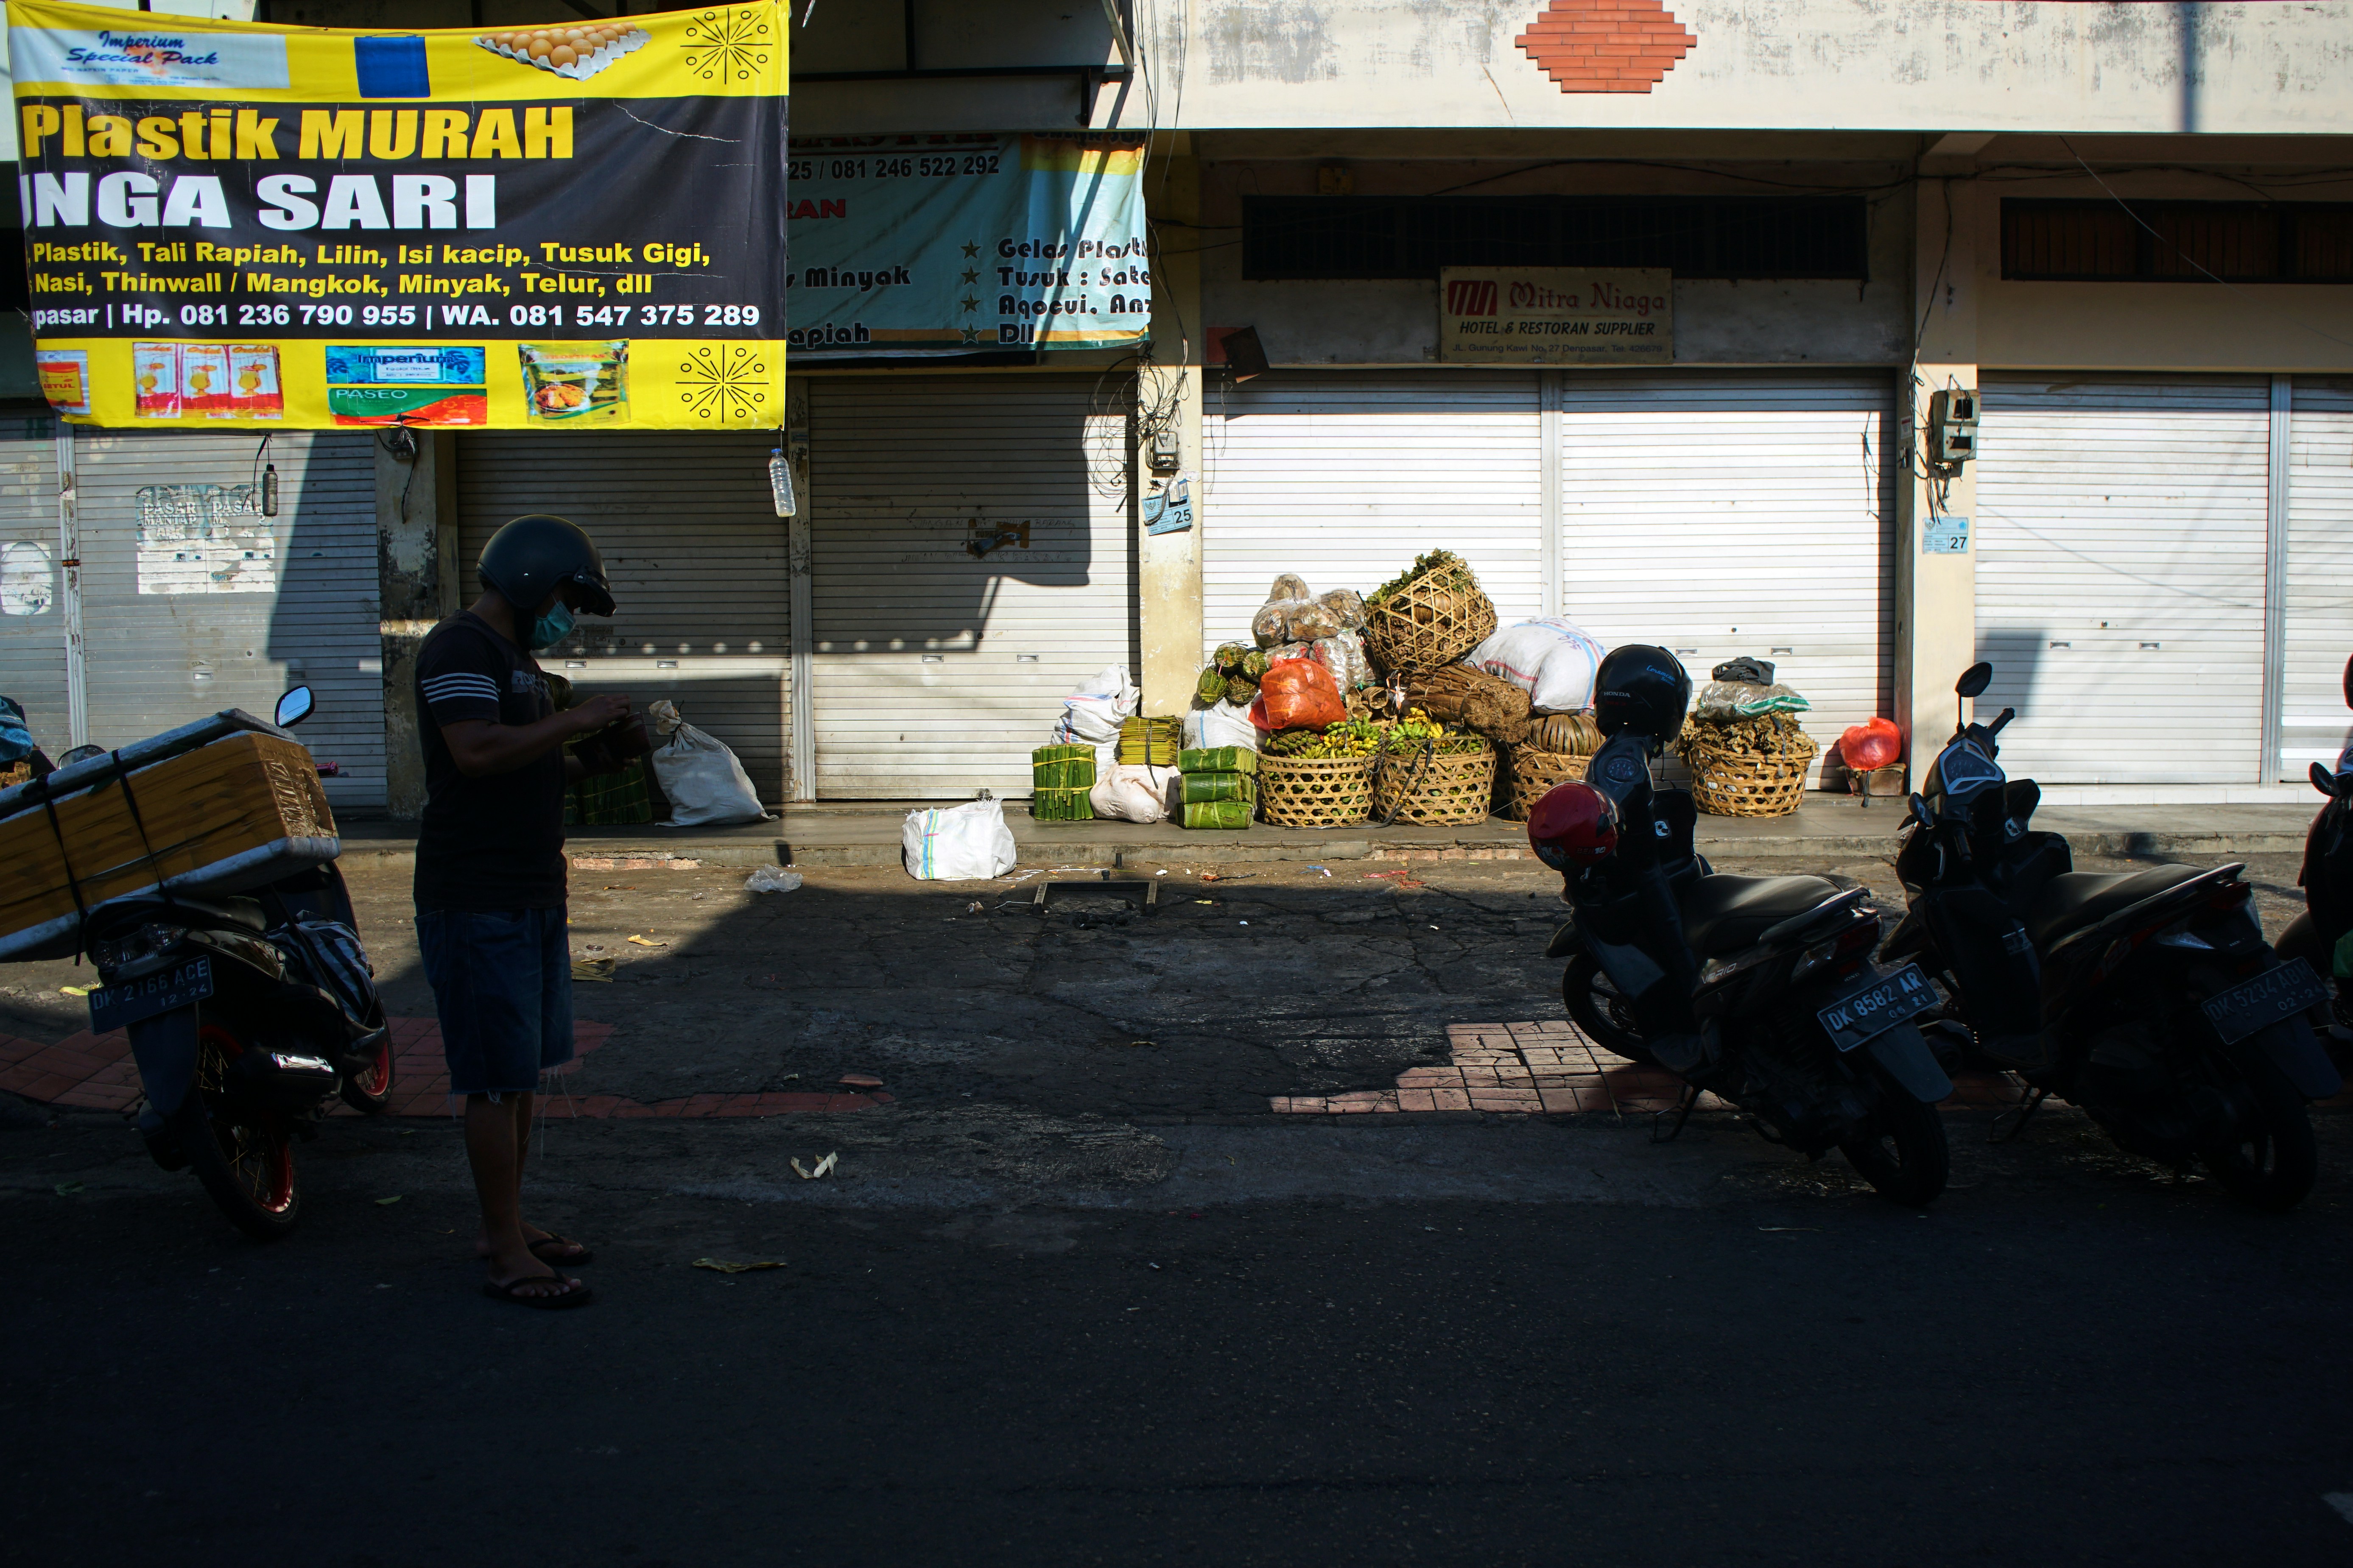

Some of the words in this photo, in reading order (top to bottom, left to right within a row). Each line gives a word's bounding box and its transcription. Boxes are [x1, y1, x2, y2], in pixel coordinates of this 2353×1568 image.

[99, 31, 184, 50] Imperium
[67, 48, 152, 64] Special
[162, 50, 219, 64] Pack
[22, 105, 279, 160] Plastik
[299, 106, 573, 160] MURAH
[832, 159, 866, 179] 081
[875, 158, 910, 178] 246
[919, 156, 956, 177] 522
[962, 155, 1000, 175] 292
[257, 175, 495, 230] SARI
[34, 242, 127, 266] Plastik,
[137, 242, 186, 262] Tali
[196, 243, 306, 268] Rapiah,
[317, 245, 388, 268] Lilin,
[399, 245, 433, 264] Isi
[443, 244, 530, 267] kacip,
[540, 242, 633, 262] Tusuk
[643, 242, 710, 268] Gigi,
[998, 238, 1068, 259] Gelas
[36, 272, 92, 296] Nasi,
[101, 272, 221, 292] Thinwall
[247, 273, 388, 298] Mangkok,
[399, 273, 510, 298] Minyak,
[520, 273, 605, 297] Telur,
[616, 273, 651, 295] dll
[805, 265, 911, 292] Minyak
[997, 266, 1070, 287] Tusuk
[1099, 265, 1151, 286] Sate
[1510, 282, 1579, 307] Mitra
[1590, 282, 1665, 316] Niaga
[123, 304, 170, 329] Hp.
[180, 304, 227, 325] 081
[239, 304, 290, 325] 236
[299, 305, 353, 325] 790
[363, 305, 416, 325] 955
[442, 305, 500, 325] WA.
[510, 305, 562, 326] 081
[576, 306, 632, 326] 547
[640, 306, 694, 326] 375
[704, 305, 760, 326] 289
[787, 323, 869, 349] apiah
[999, 324, 1034, 343] Dll
[1460, 321, 1499, 334] HOTEL
[1505, 322, 1514, 334] &
[1519, 322, 1589, 335] RESTORAN
[1595, 322, 1655, 335] SUPPLIER
[358, 353, 454, 365] Imperium
[1469, 344, 1504, 353] Gunung
[1506, 344, 1527, 352] Kawi
[336, 389, 408, 399] PASEO
[144, 502, 196, 515] PASAR
[1174, 509, 1191, 524] 25
[144, 514, 197, 526] MANTAP
[1950, 536, 1967, 549] 27
[92, 989, 117, 1011] DK
[123, 974, 168, 1002] 2166
[174, 960, 208, 985] ACE
[1826, 1005, 1855, 1031] DK
[1853, 985, 1898, 1017] 8582
[1897, 972, 1923, 995] AR
[1911, 993, 1928, 1008] 21
[2207, 996, 2235, 1021] DK
[2232, 977, 2278, 1008] 5234
